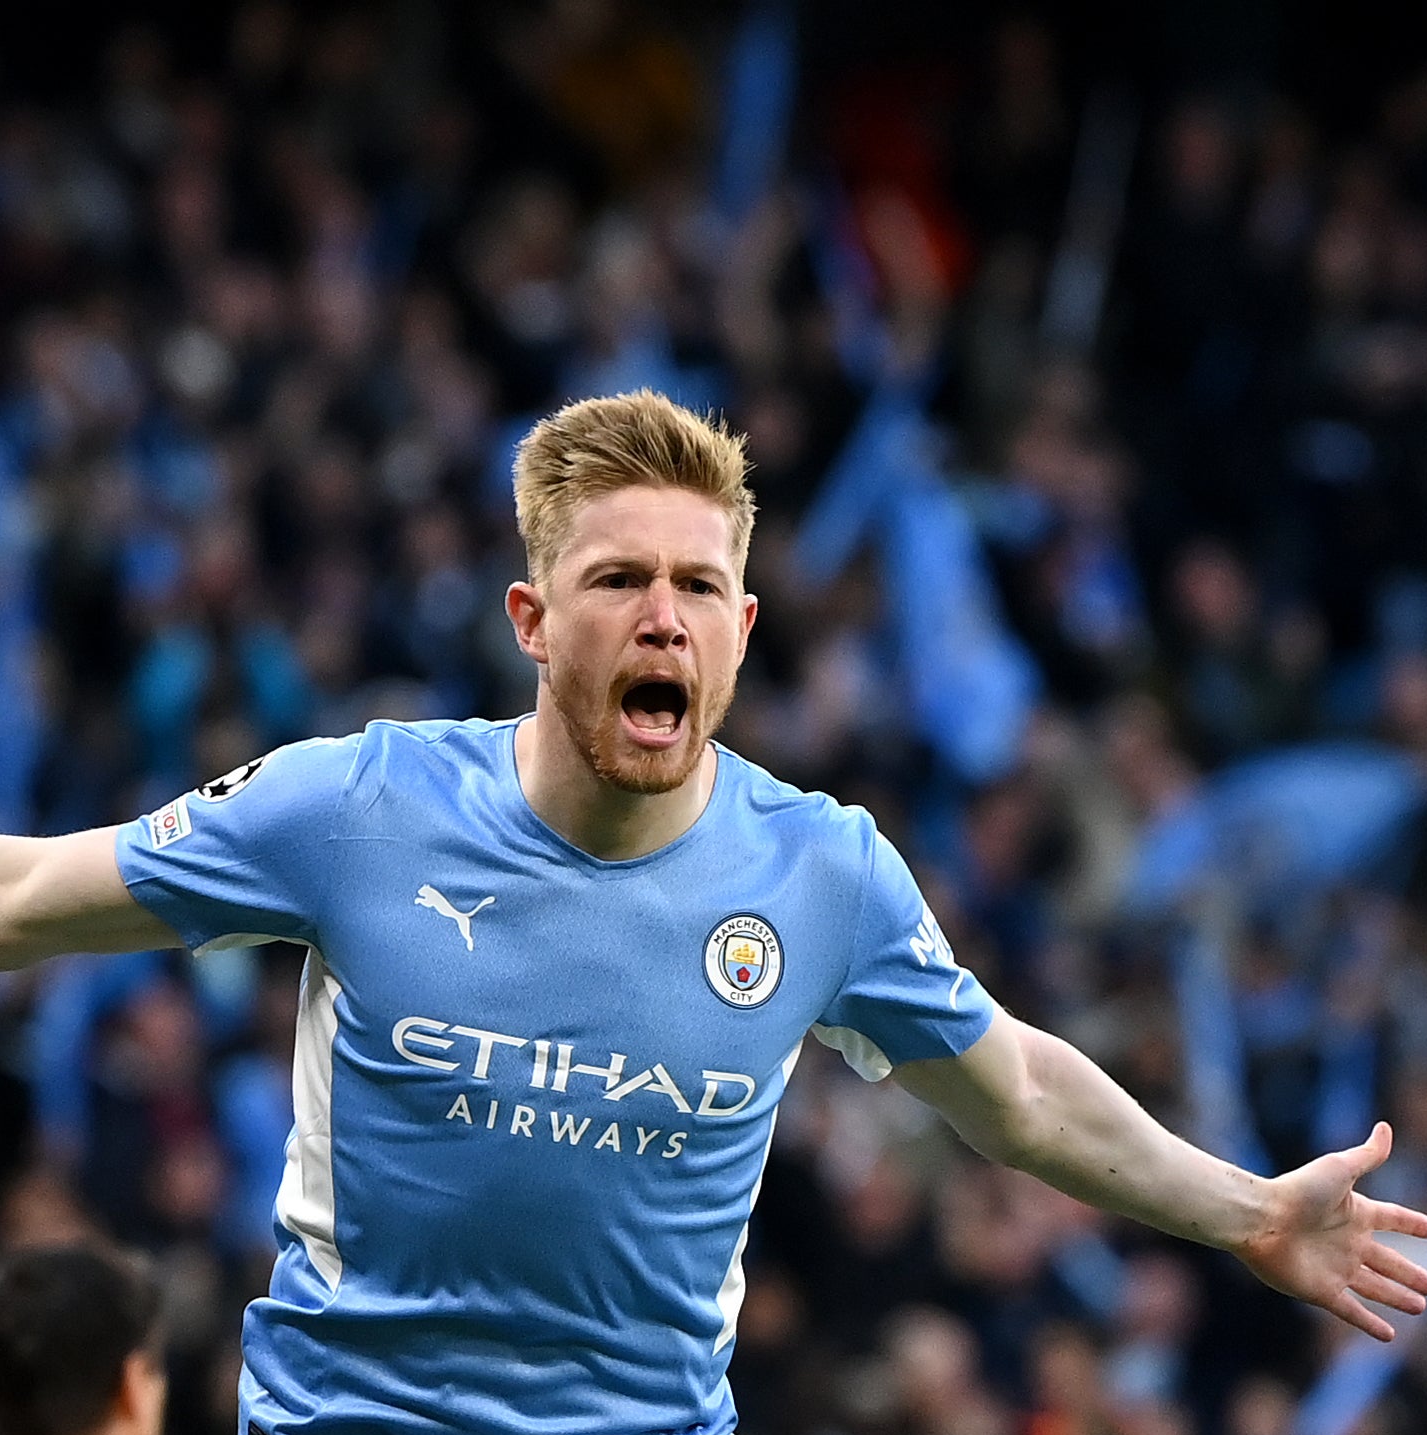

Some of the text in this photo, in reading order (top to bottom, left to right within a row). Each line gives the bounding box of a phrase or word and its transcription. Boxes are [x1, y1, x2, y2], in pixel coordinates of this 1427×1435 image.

[713, 919, 777, 953] MANCHESTER
[730, 991, 753, 1003] CITY
[391, 1016, 756, 1117] ETIHAD
[446, 1093, 687, 1158] AIRWAYS
